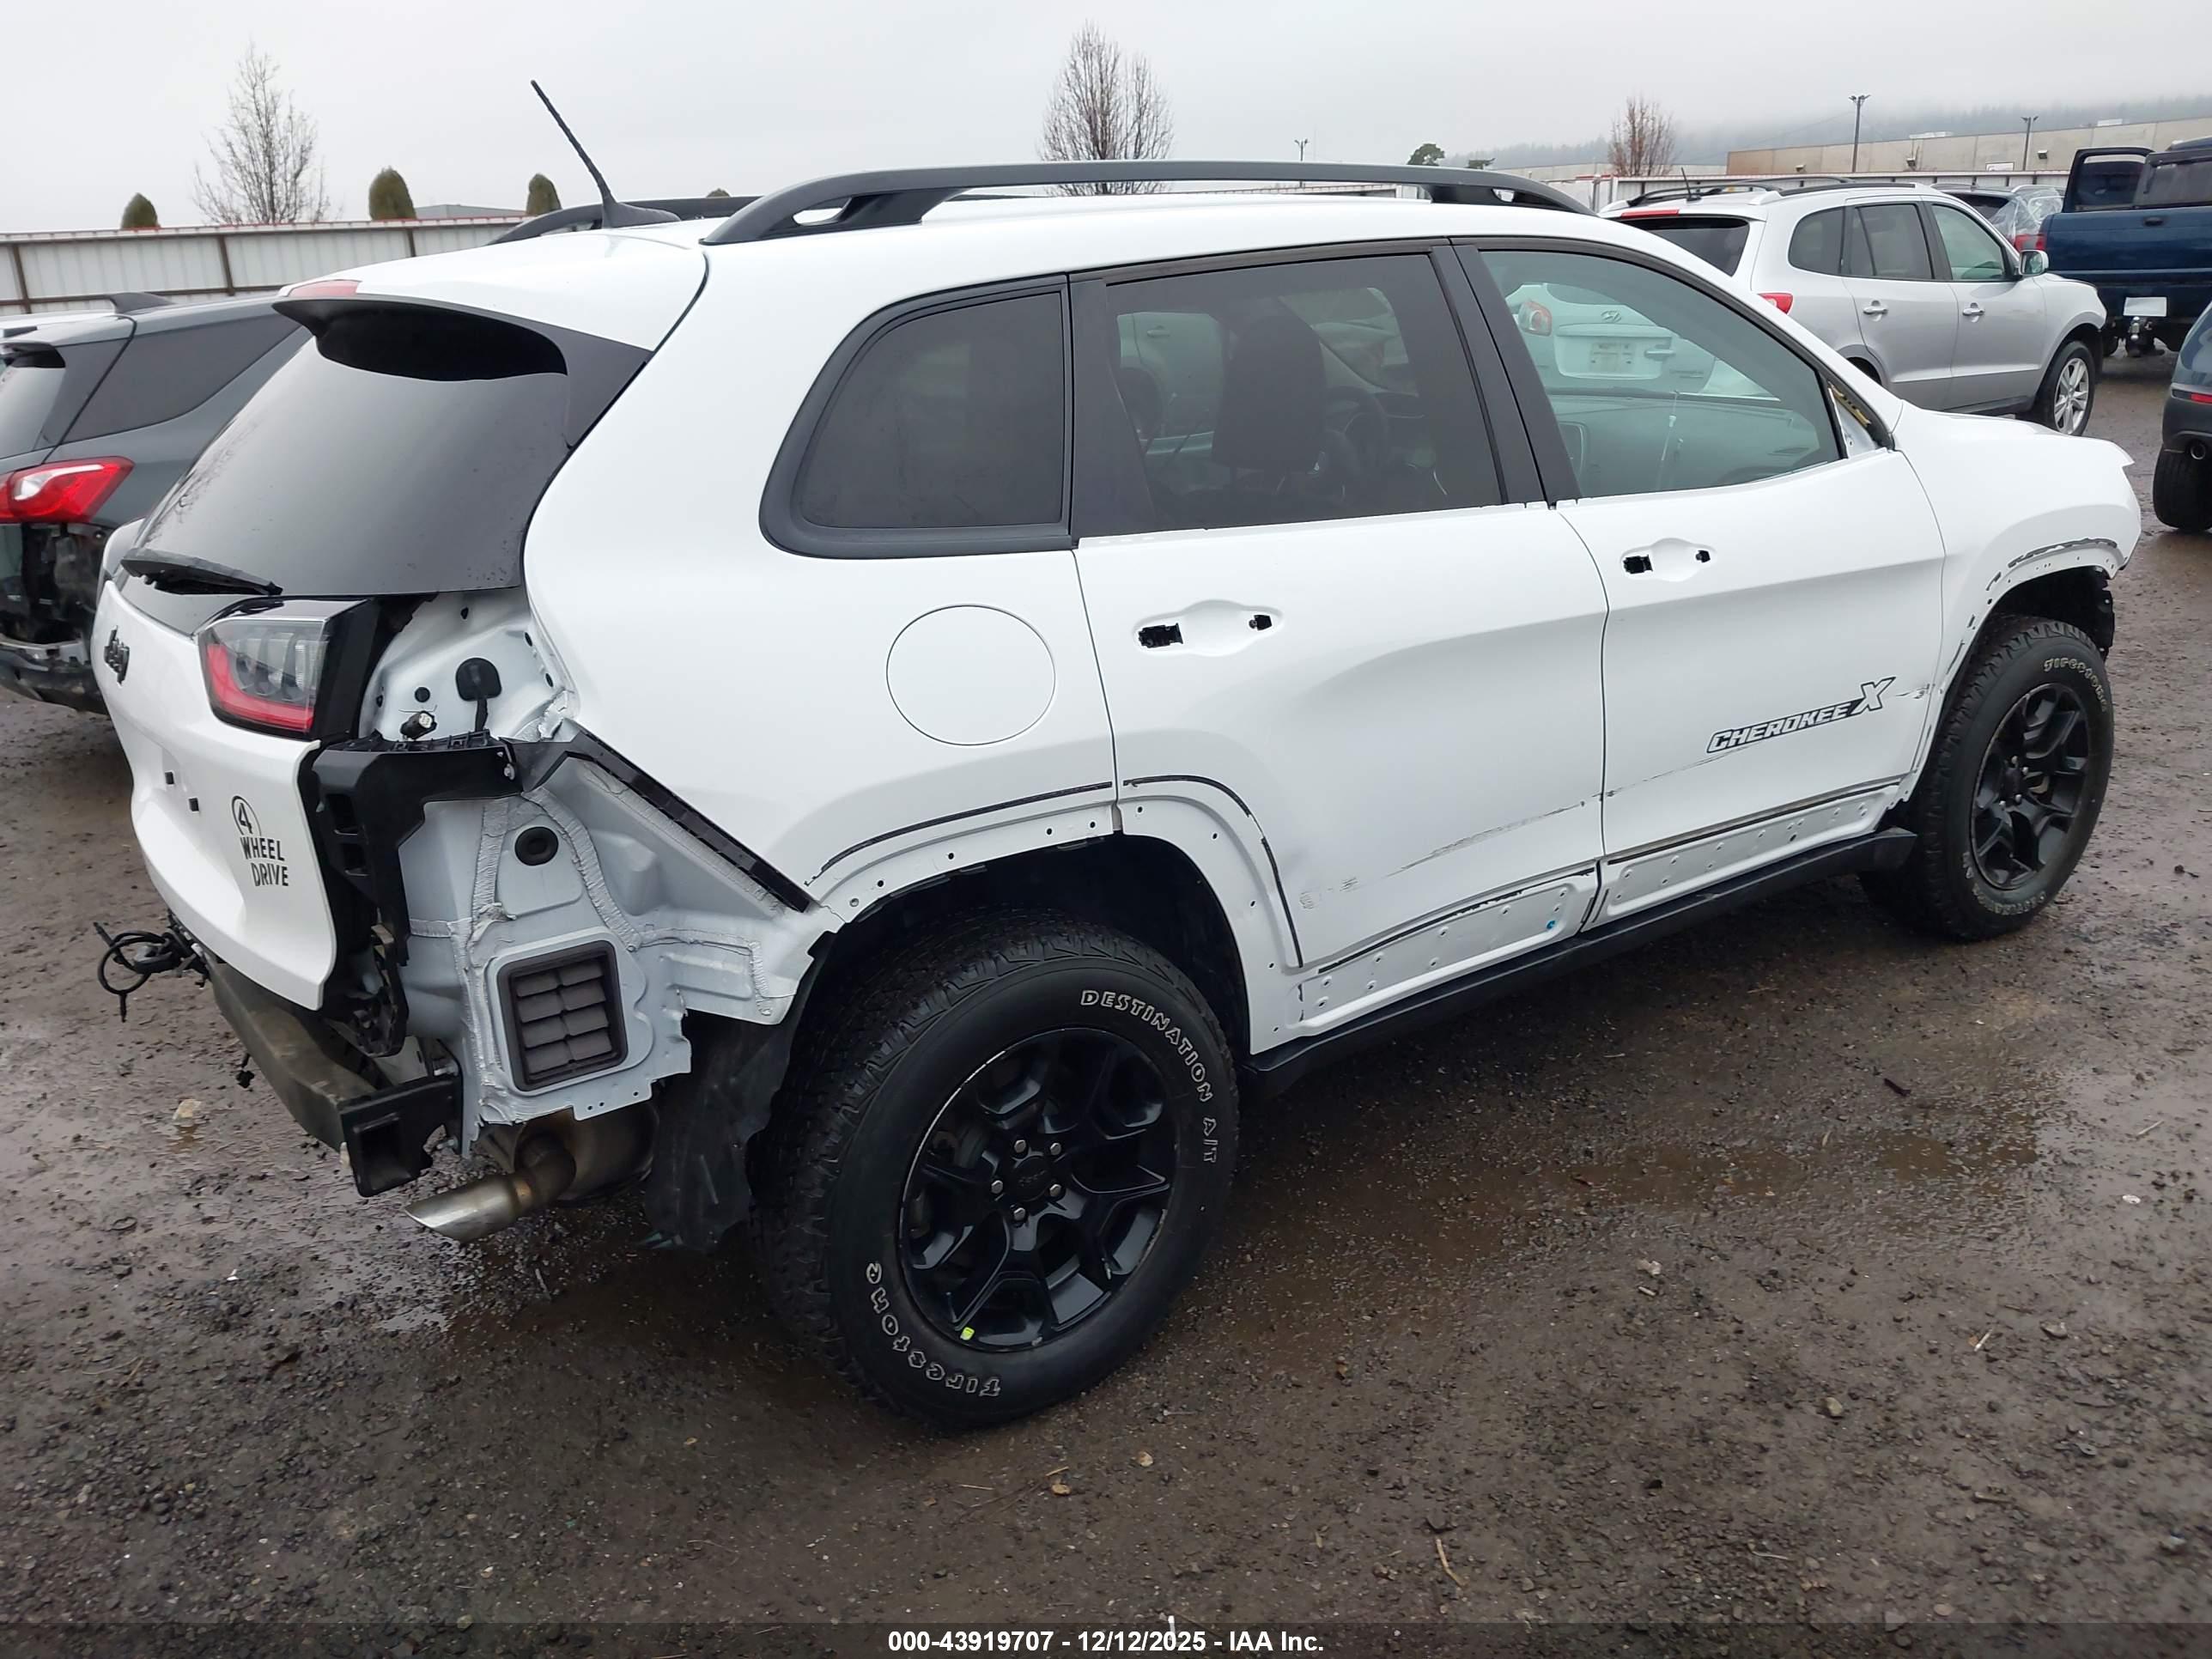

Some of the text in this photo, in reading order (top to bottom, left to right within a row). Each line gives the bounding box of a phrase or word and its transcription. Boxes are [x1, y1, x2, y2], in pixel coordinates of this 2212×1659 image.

[1707, 677, 1896, 752] CHEROKEE X
[240, 836, 285, 861] WHEEL
[251, 862, 289, 887] DRIVE
[1080, 989, 1213, 1103] DESTINATION
